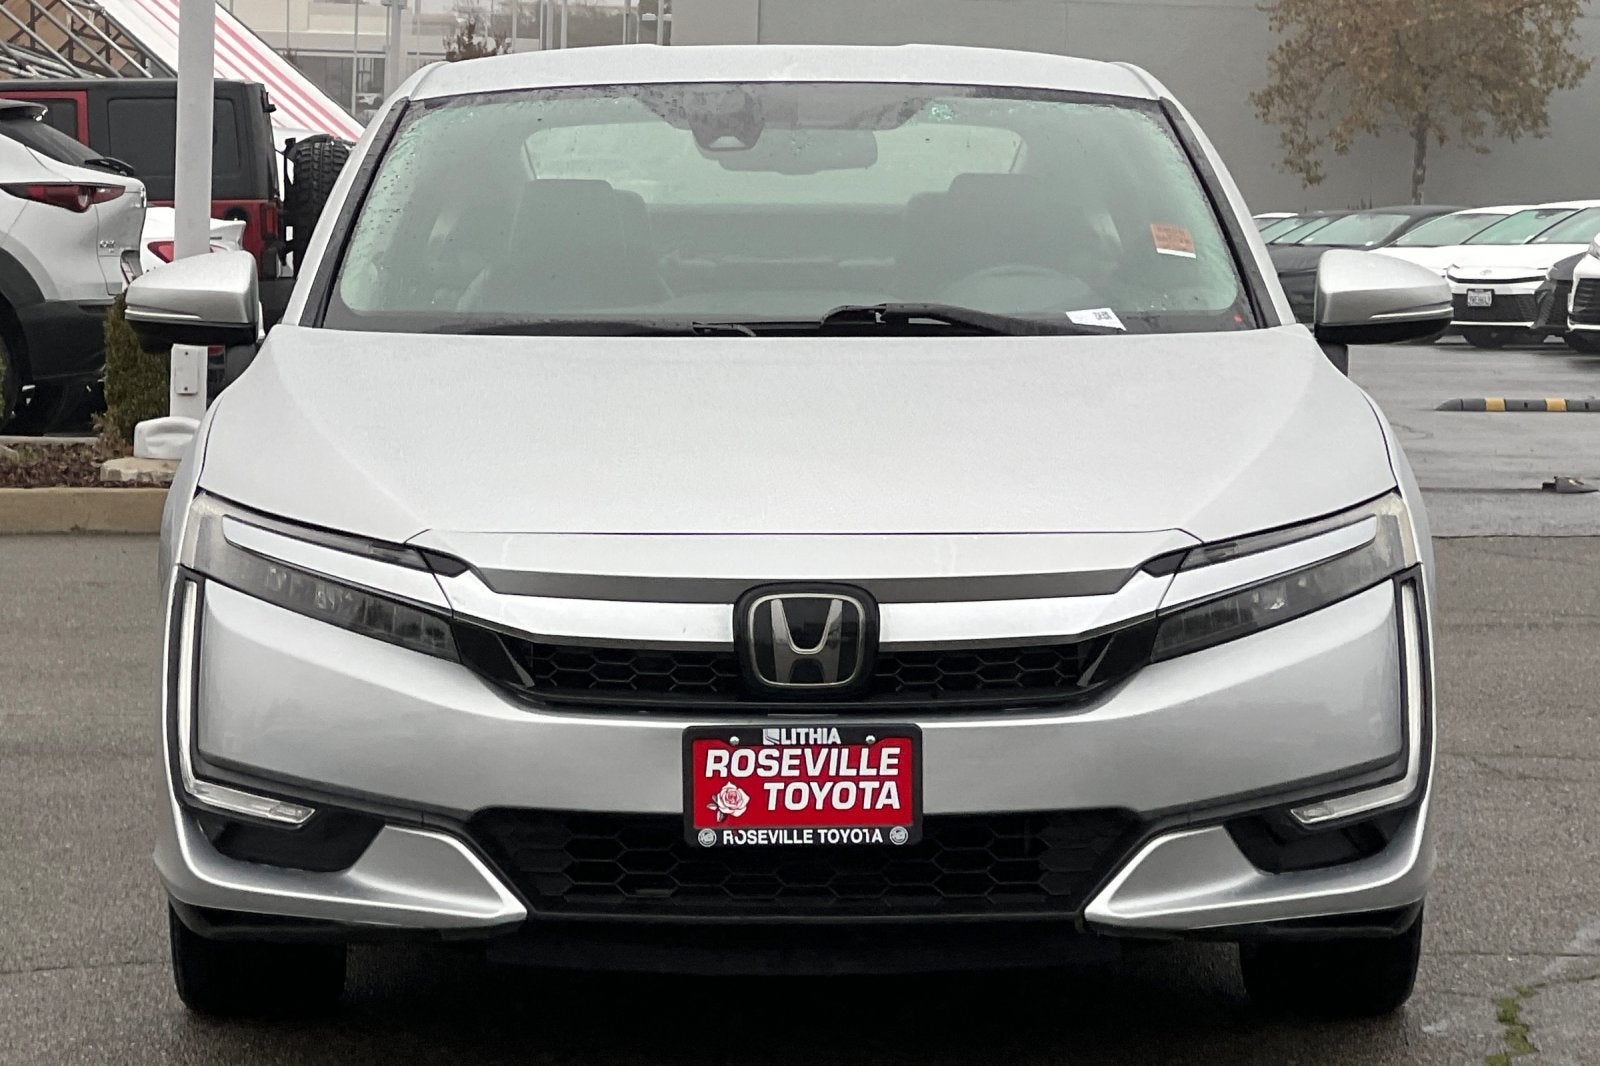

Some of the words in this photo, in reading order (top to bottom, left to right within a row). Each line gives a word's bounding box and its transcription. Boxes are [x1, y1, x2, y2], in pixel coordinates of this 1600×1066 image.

[780, 727, 842, 745] LITHIA
[705, 747, 900, 778] ROSEVILLE
[763, 780, 900, 811] TOYOTA
[723, 829, 813, 845] ROSEVILLE
[817, 828, 884, 844] TOYOTA
